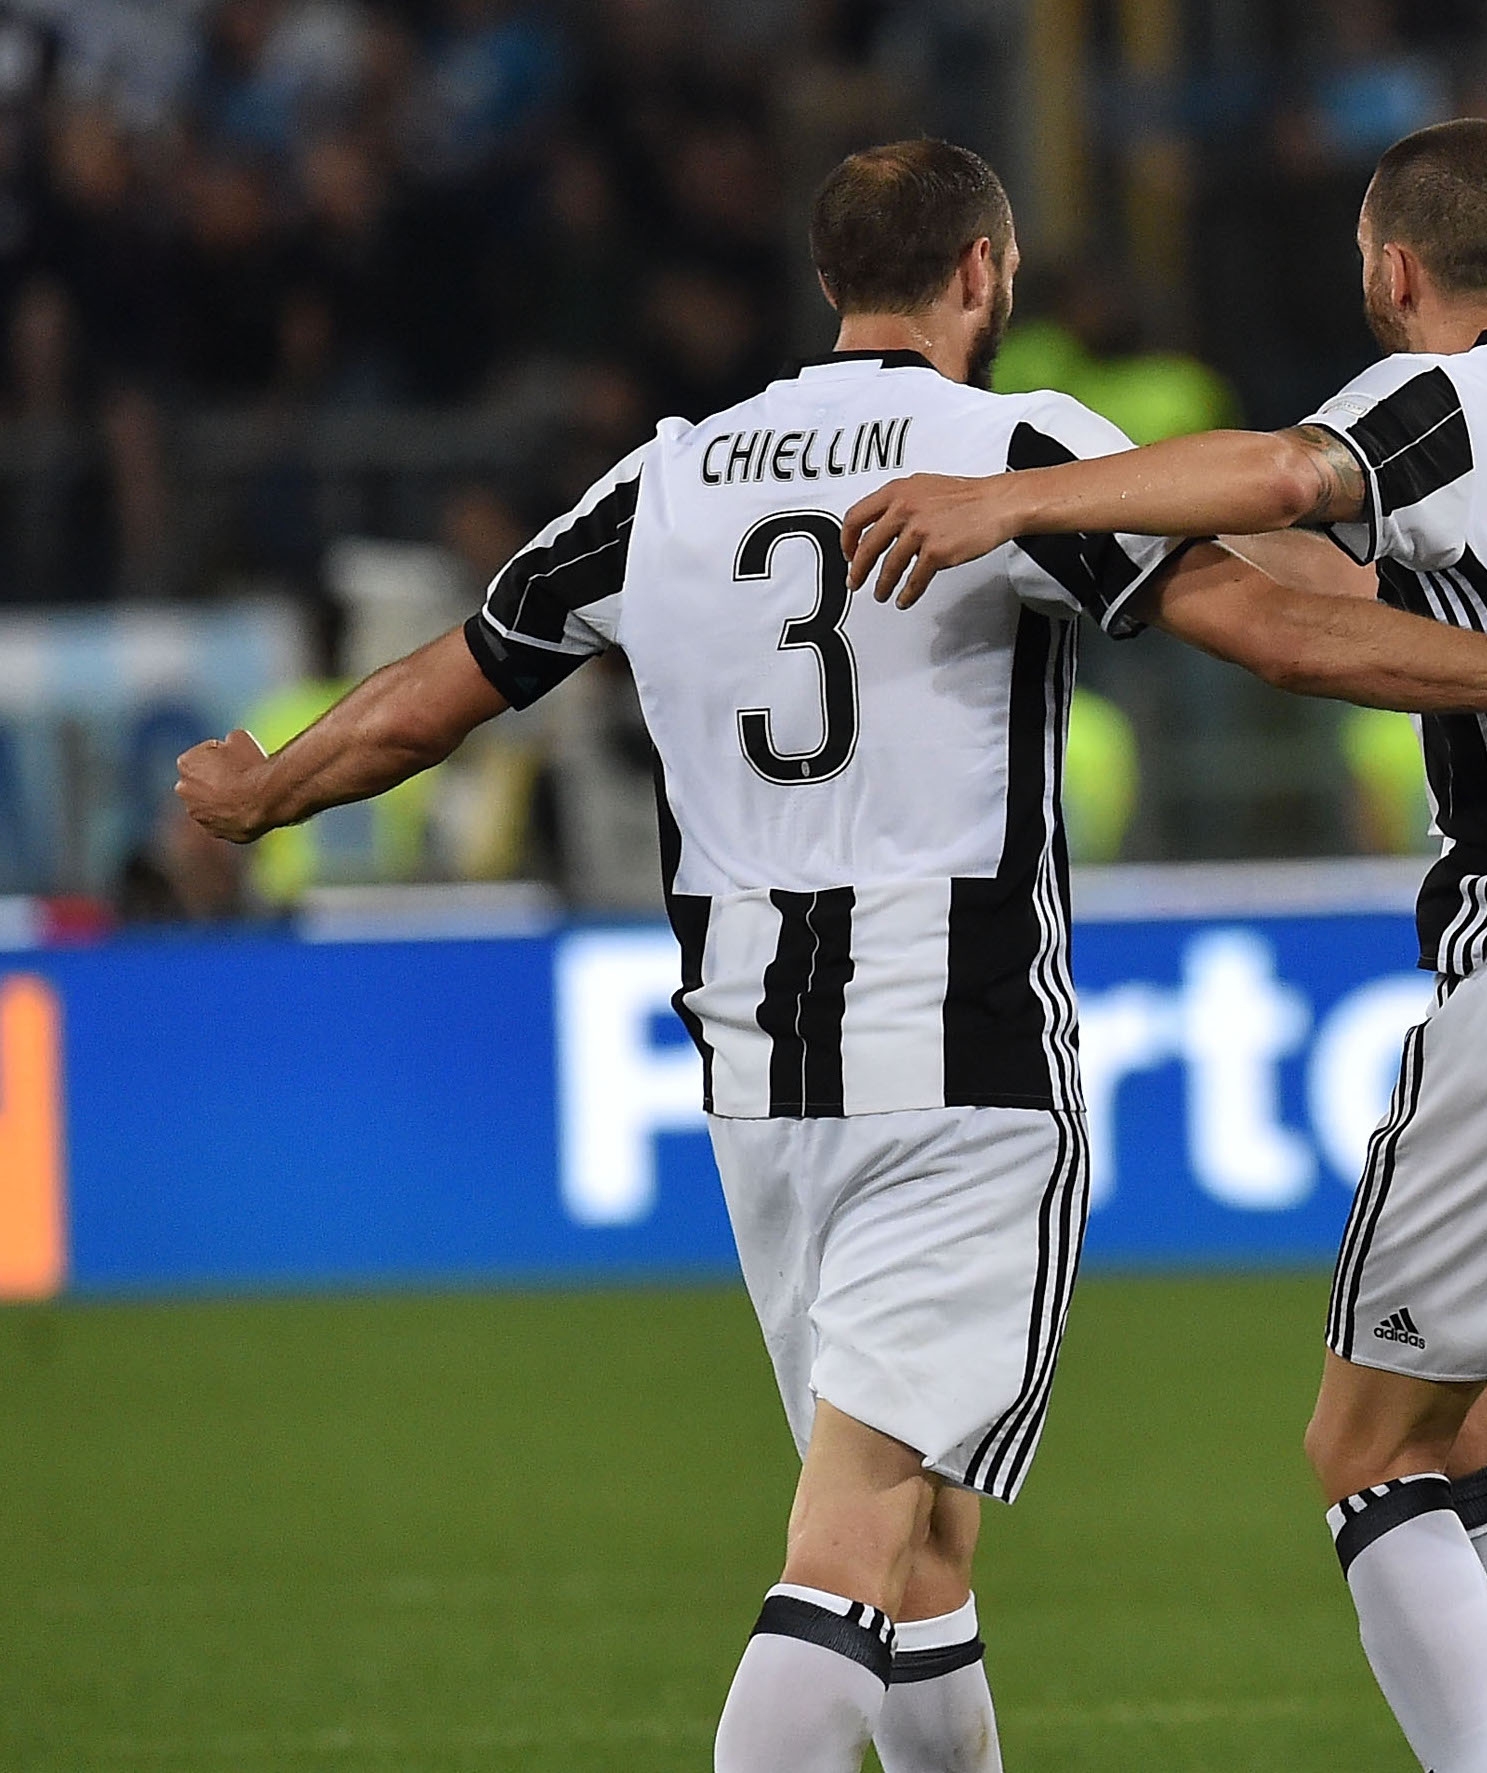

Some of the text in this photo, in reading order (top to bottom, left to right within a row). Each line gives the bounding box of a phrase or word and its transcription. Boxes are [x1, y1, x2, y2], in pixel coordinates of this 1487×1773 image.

[700, 416, 913, 486] CHIELLINI
[733, 509, 860, 786] 3
[1373, 1327, 1426, 1350] adidas
